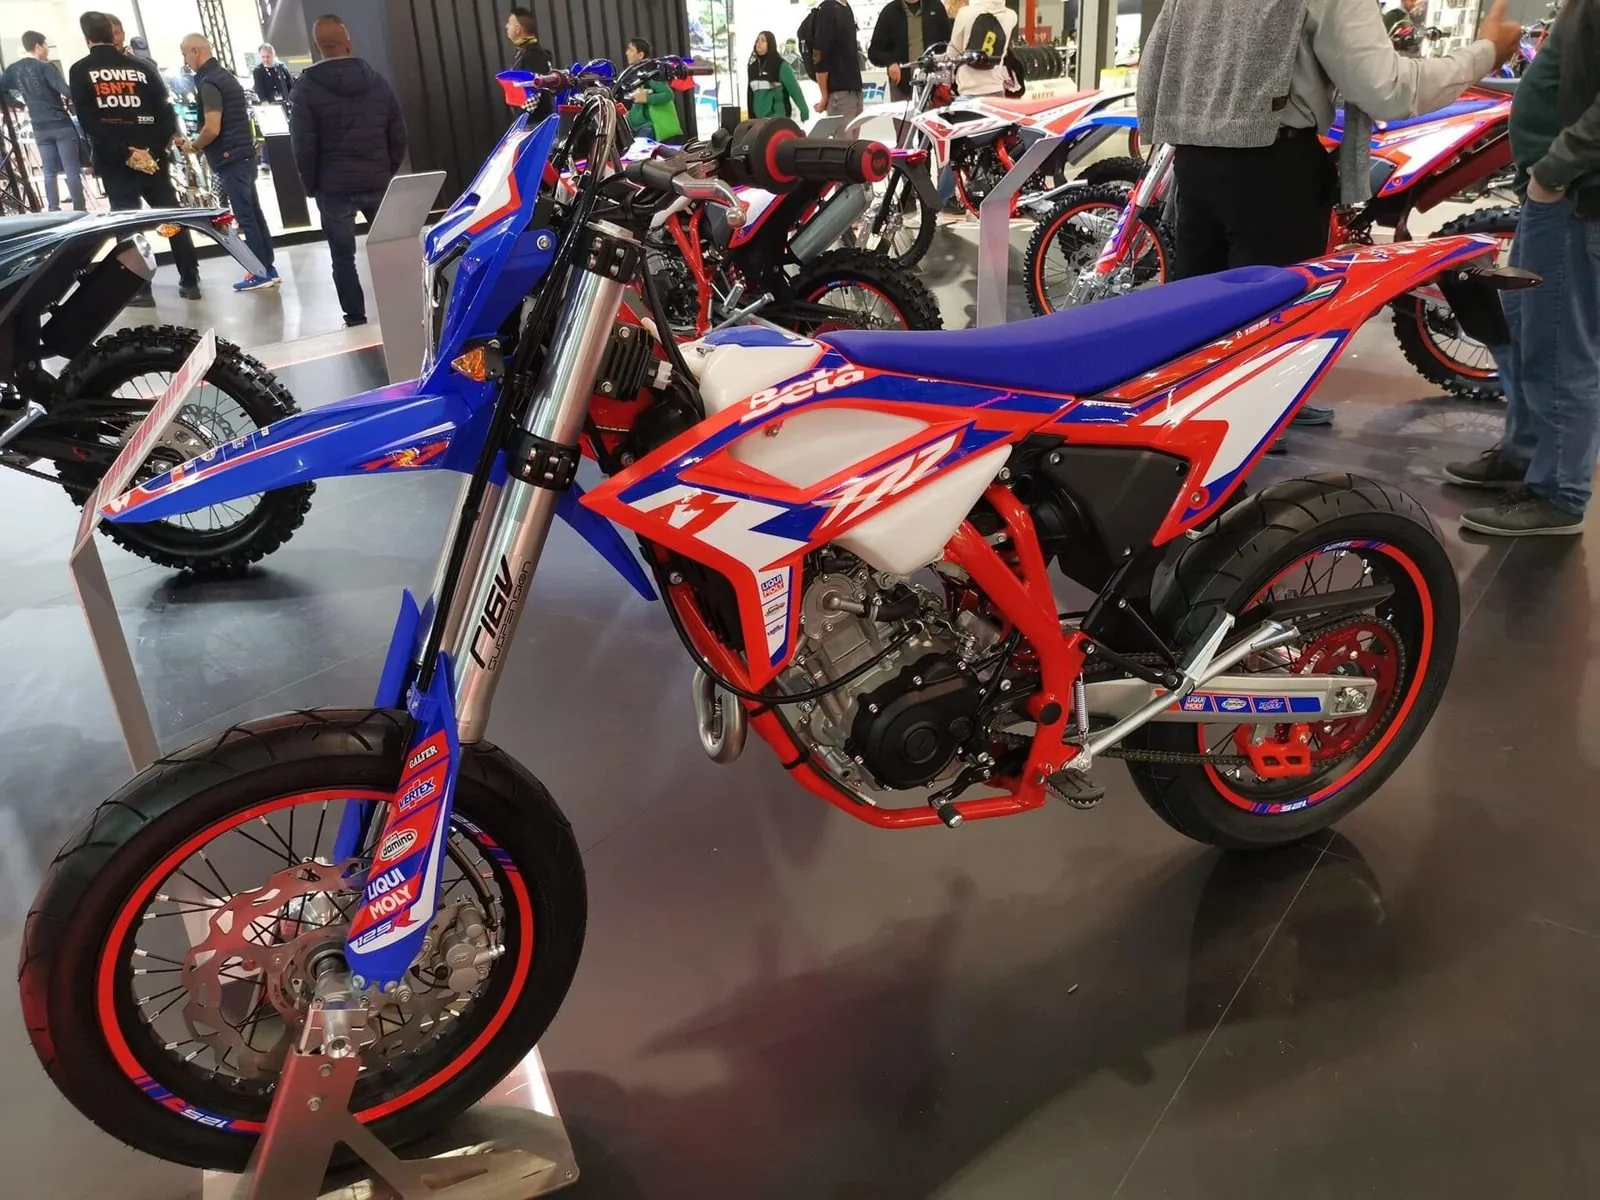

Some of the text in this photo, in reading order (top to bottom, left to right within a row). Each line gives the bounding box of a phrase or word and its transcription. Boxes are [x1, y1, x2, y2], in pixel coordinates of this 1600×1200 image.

[88, 69, 148, 84] POWER
[94, 82, 136, 95] ISN'T
[96, 95, 141, 108] LOUD
[740, 364, 864, 425] Beta
[761, 575, 782, 591] LIQUI
[763, 582, 784, 597] MOLY
[409, 745, 437, 769] GALFER
[399, 778, 435, 809] VERTEX
[382, 833, 414, 857] domino
[367, 867, 405, 900] LIQUI
[369, 886, 413, 920] MOLY
